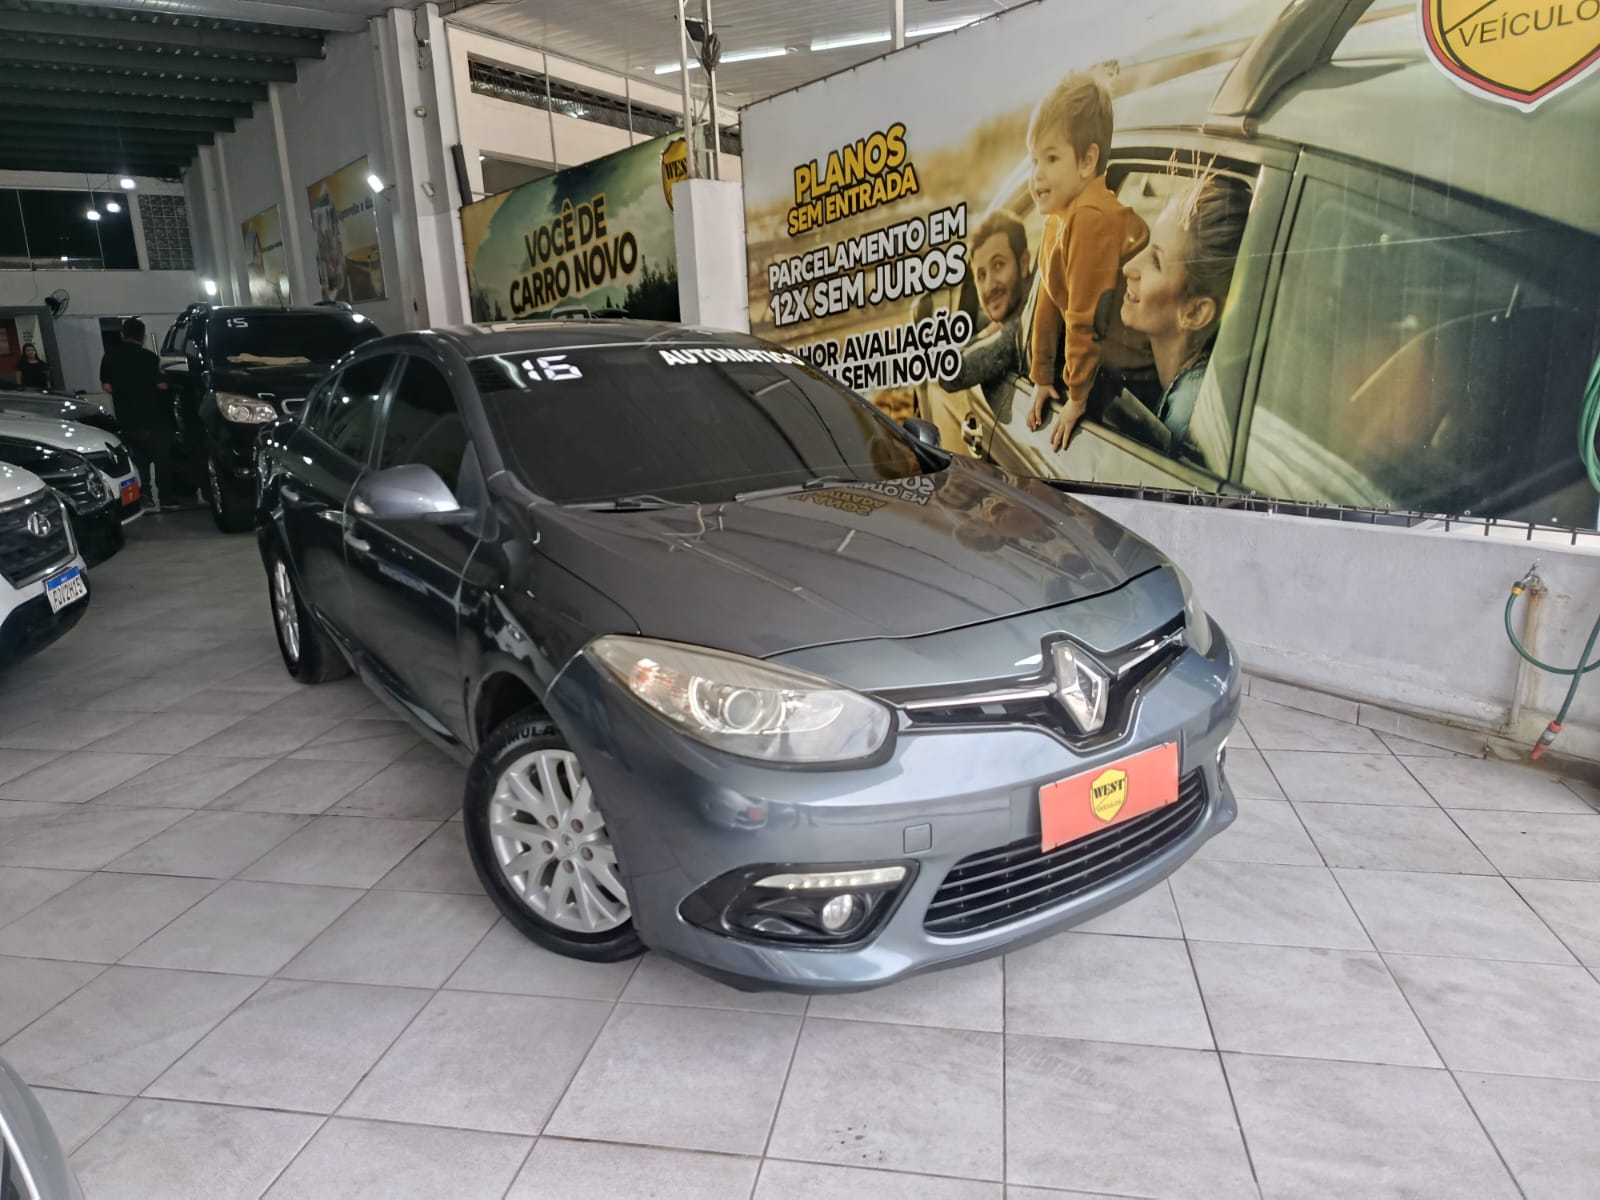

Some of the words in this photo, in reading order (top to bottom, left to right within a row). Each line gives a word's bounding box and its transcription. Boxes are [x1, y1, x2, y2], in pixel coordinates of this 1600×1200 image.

[1458, 0, 1600, 47] VEÍCULO
[664, 157, 688, 180] WES
[795, 123, 906, 204] PLANOS
[788, 200, 823, 235] SEM
[826, 163, 918, 223] ENTRADA
[525, 200, 576, 268] VOCÊ
[577, 197, 607, 246] DE
[768, 217, 926, 291] PARCELAMENTO
[929, 202, 967, 246] EM
[510, 260, 571, 315] CARRO
[573, 231, 638, 293] NOVO
[769, 286, 811, 327] 12X
[813, 270, 865, 318] SEM
[869, 241, 967, 305] JUROS
[227, 318, 249, 328] 15
[794, 341, 839, 368] HOR
[843, 310, 970, 363] AVALIAÇÃO
[521, 354, 583, 381] 16
[842, 359, 887, 390] SEMI
[892, 349, 960, 384] NOVO
[1093, 777, 1125, 799] WEST
